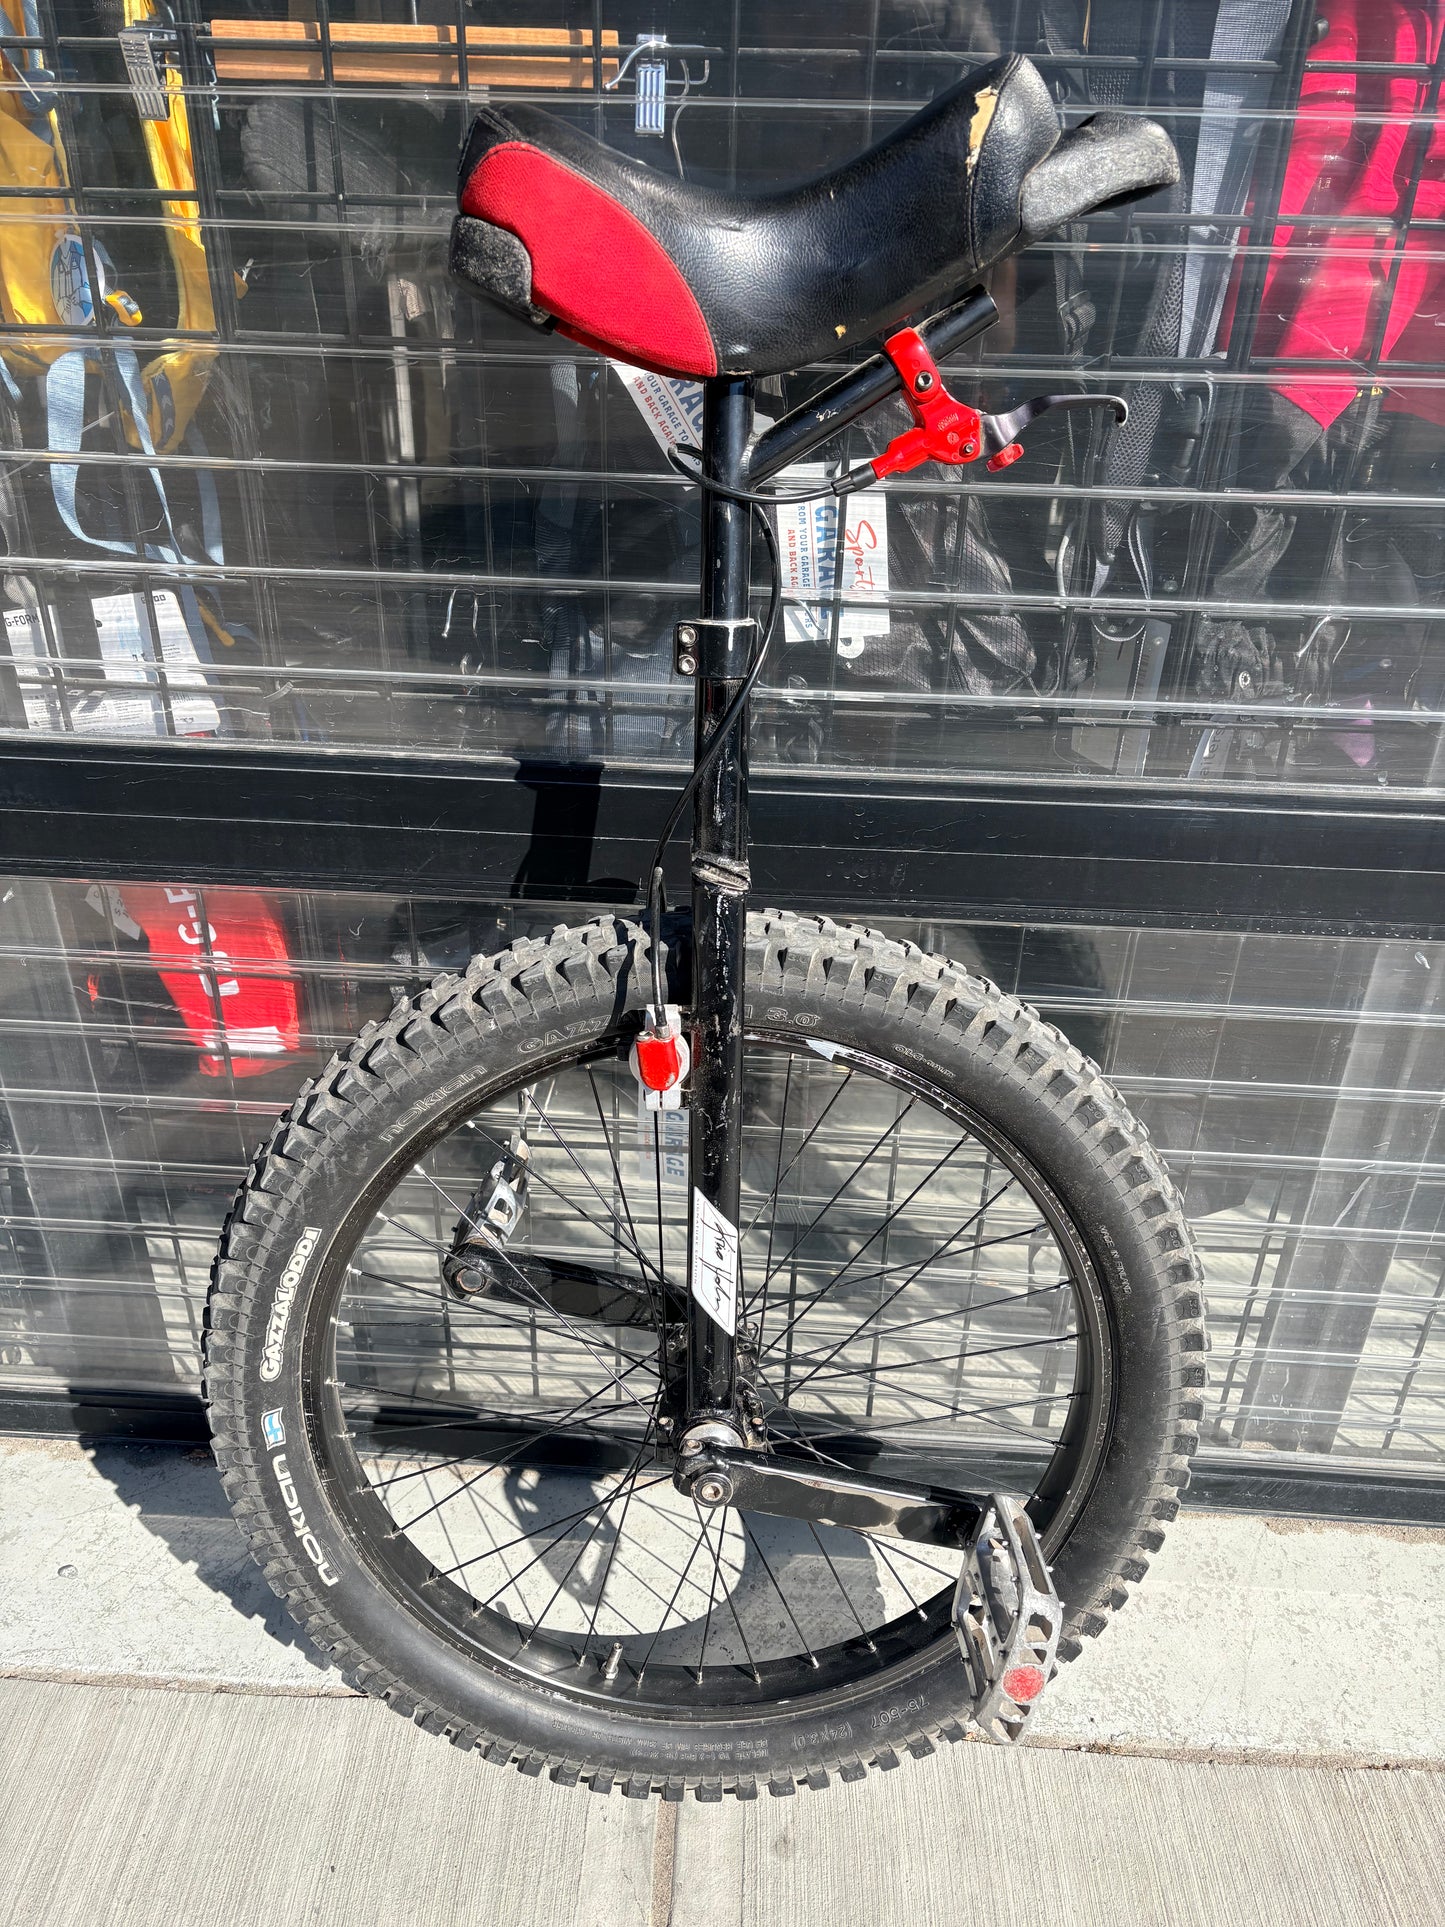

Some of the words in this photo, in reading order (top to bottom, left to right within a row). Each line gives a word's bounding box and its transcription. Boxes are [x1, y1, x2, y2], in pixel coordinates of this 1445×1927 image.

[633, 376, 648, 395] AND
[644, 396, 662, 419] BACK
[669, 379, 704, 433] RAG
[658, 394, 682, 429] GARAGE
[678, 429, 689, 442] TO
[798, 502, 806, 525] ROM
[788, 529, 797, 547] AND
[800, 528, 808, 552] YOUR
[845, 519, 878, 592] Sport
[788, 551, 798, 574] BACK
[801, 555, 811, 587] GARAGE
[5, 613, 41, 628] G-FORM
[378, 1065, 487, 1144] nokian
[260, 1226, 323, 1382] GAZZALODDI
[272, 1454, 339, 1587] nokian
[871, 1694, 930, 1729] 75-507
